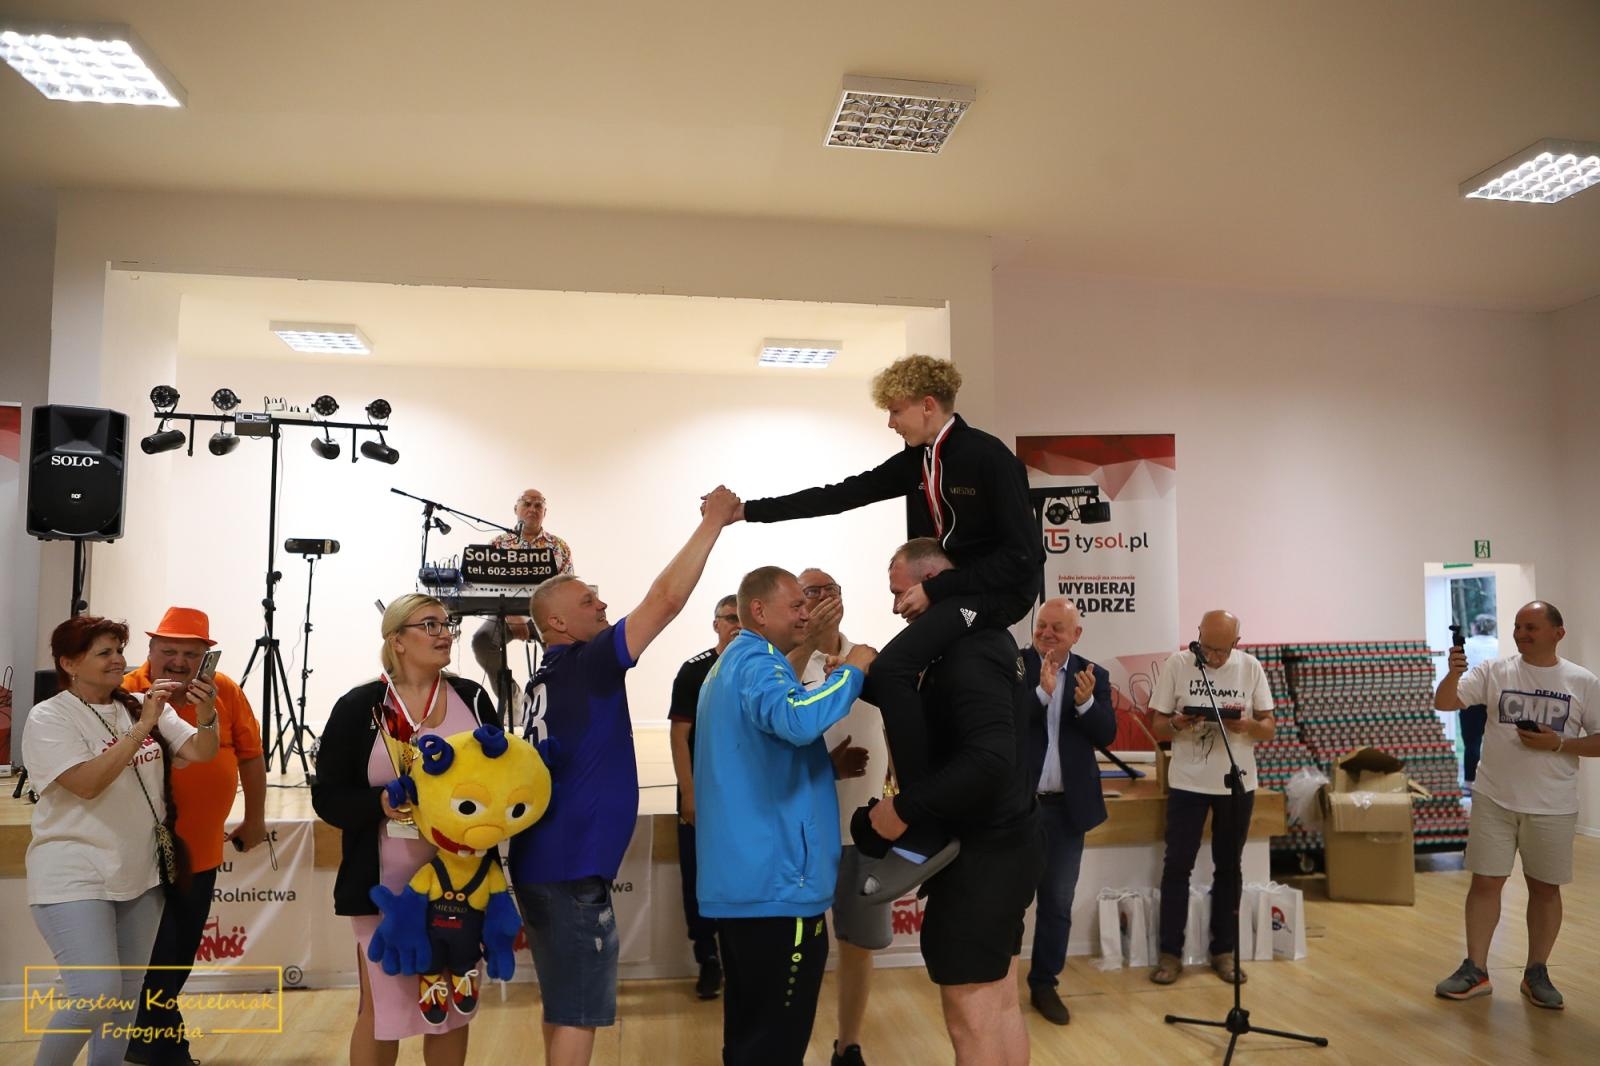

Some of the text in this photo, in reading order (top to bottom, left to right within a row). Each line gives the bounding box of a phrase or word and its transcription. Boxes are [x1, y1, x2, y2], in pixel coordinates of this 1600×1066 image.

[465, 548, 551, 563] Solo-Band
[467, 565, 552, 576] tel. 602-353-320
[1058, 582, 1135, 597] WYBIERAJ
[1068, 598, 1136, 618] ĄDRZE
[1503, 695, 1566, 725] CMP
[212, 888, 297, 903] Rolnictwa
